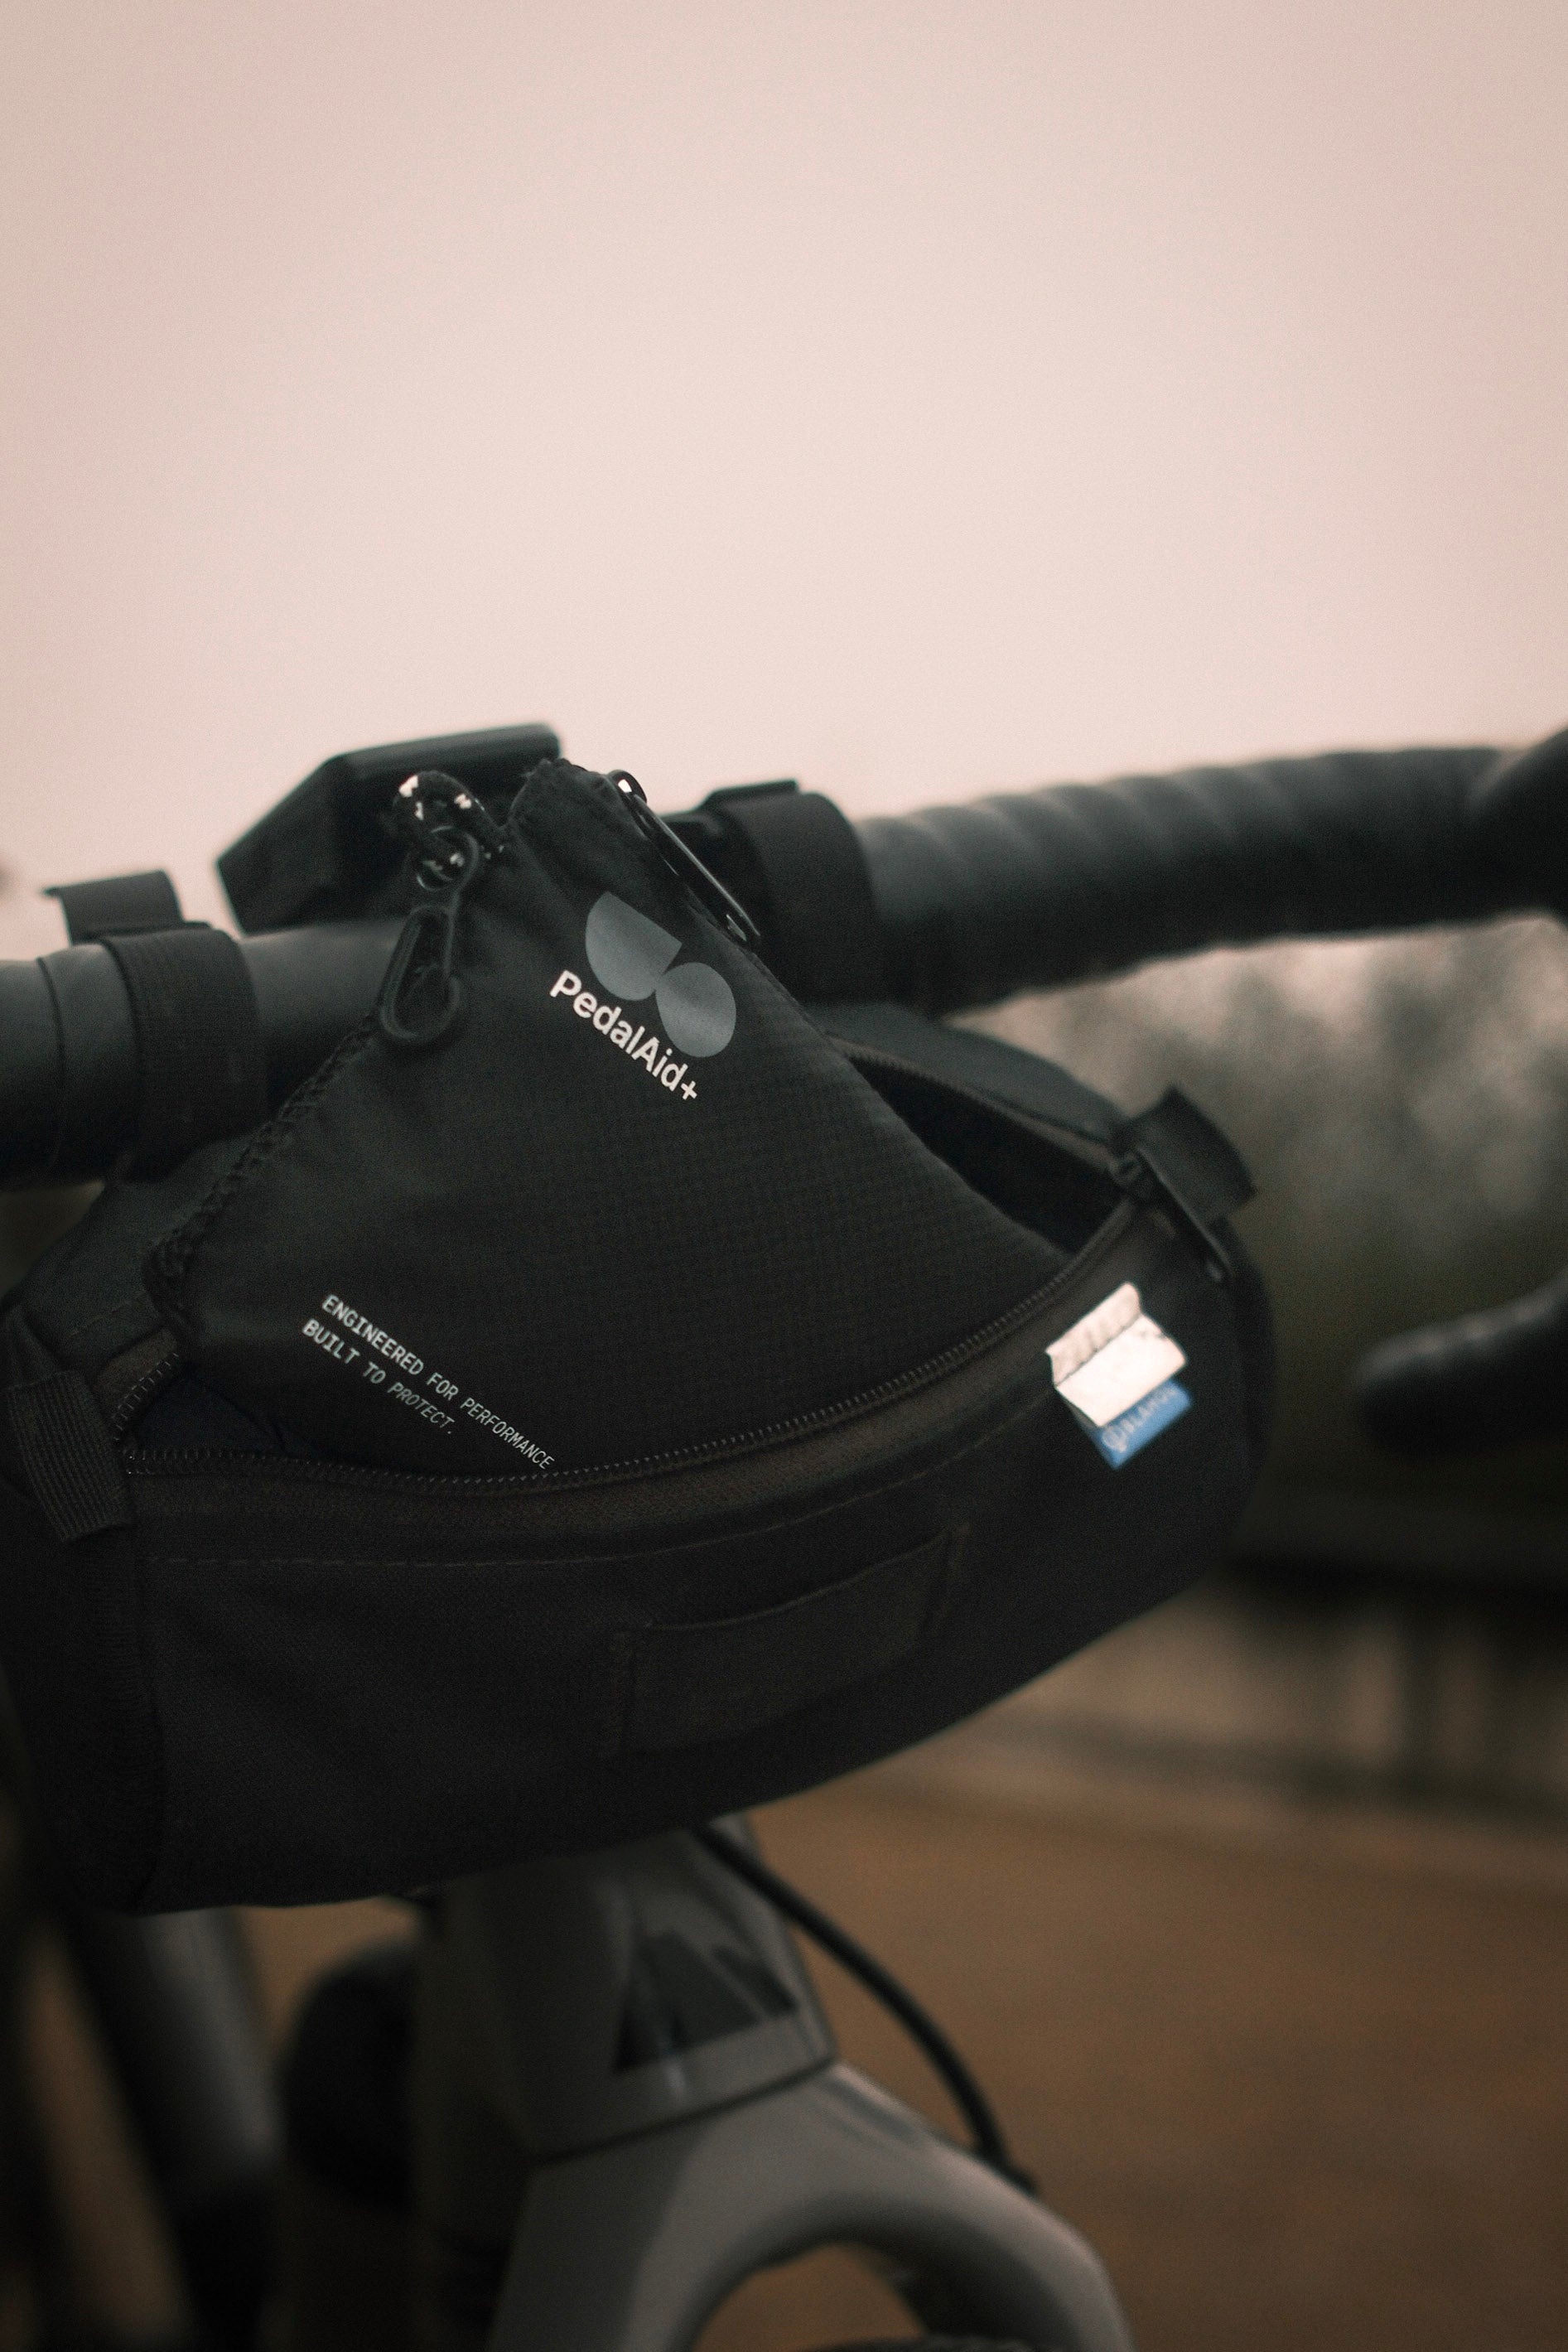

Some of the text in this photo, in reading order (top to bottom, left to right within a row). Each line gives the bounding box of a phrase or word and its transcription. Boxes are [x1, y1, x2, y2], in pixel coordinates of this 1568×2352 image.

[549, 969, 698, 1101] PedalAid+
[302, 1318, 456, 1435] BUILT TO PROTECT.
[321, 1294, 555, 1470] ENGINEERED FOR PERFORMANCE
